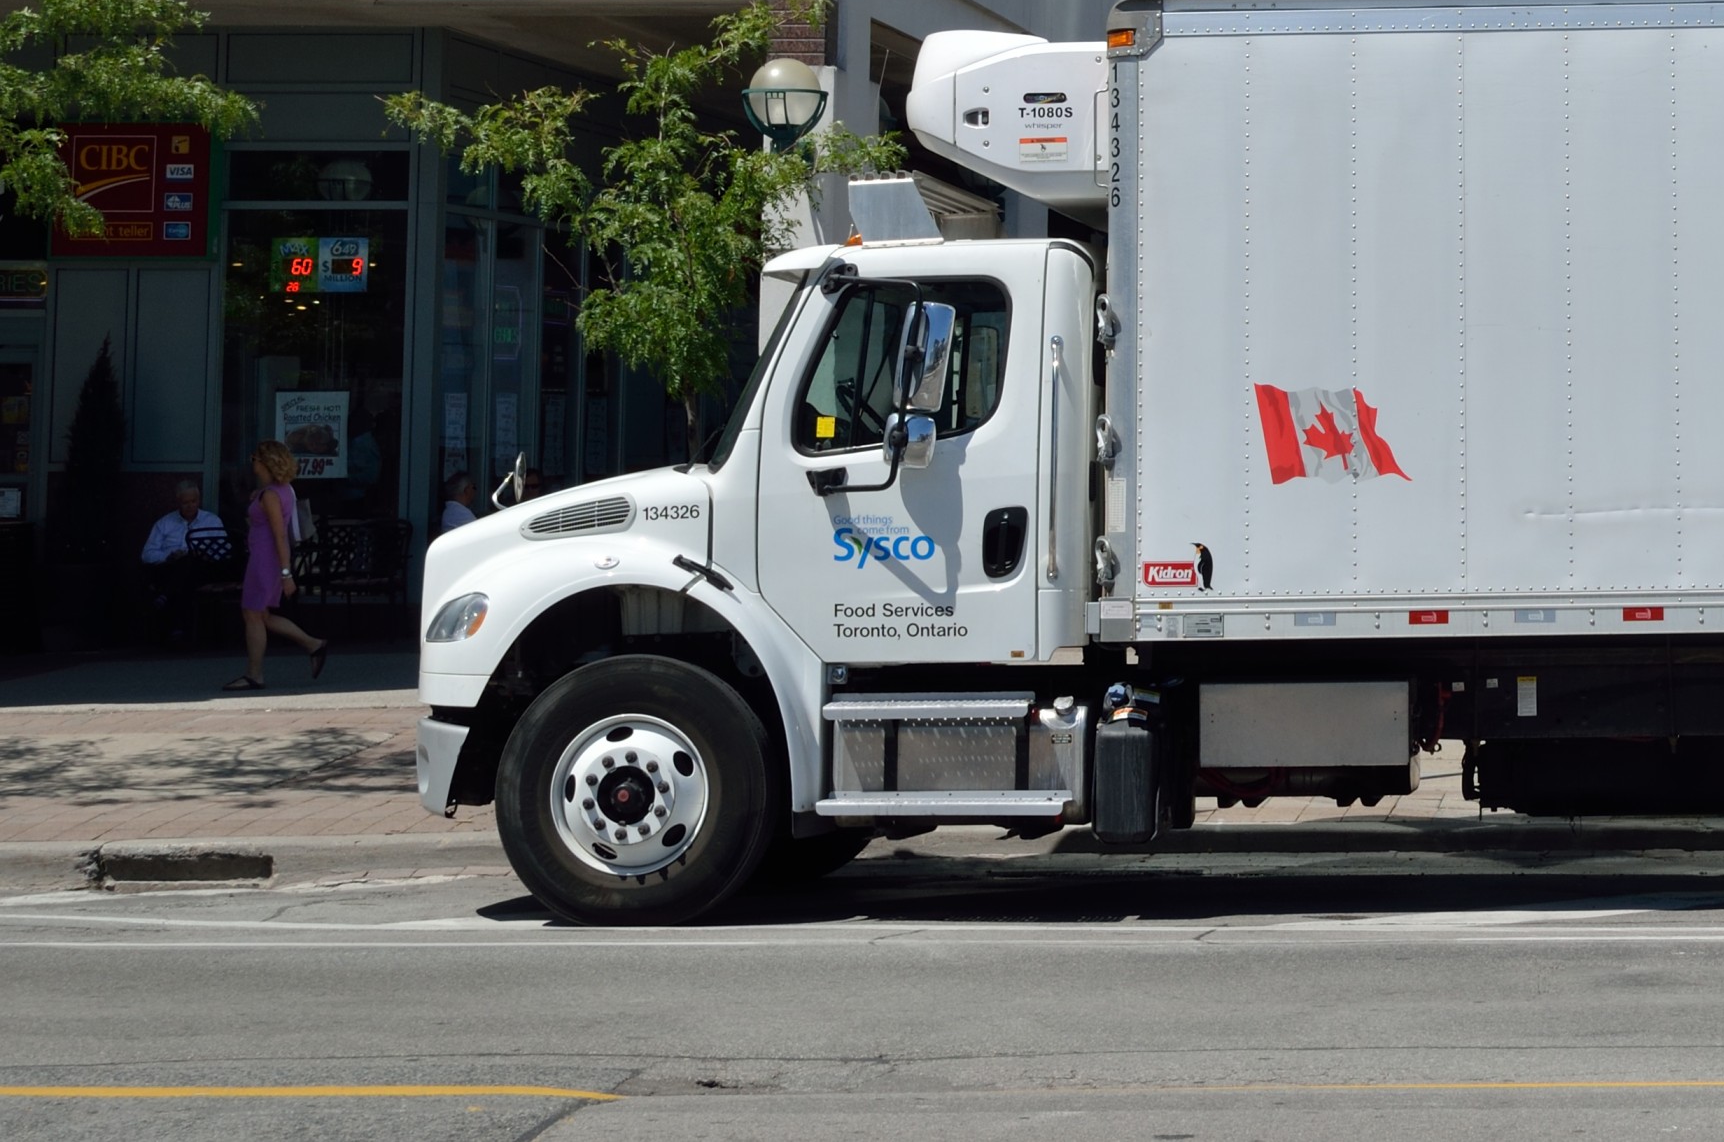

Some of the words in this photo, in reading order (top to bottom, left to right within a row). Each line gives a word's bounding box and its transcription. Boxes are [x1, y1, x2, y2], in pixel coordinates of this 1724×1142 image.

[1018, 106, 1073, 118] T-1080S
[1024, 122, 1063, 130] whisper
[1110, 63, 1121, 208] 134326
[79, 144, 150, 171] CIBC
[169, 166, 194, 176] VISA
[118, 224, 150, 237] teller
[291, 258, 313, 276] 60
[351, 257, 364, 276] 9
[324, 275, 362, 283] MILLION
[284, 413, 312, 422] Roasted
[313, 413, 341, 422] Chicken
[642, 504, 701, 522] 134326
[833, 515, 861, 525] Good
[862, 514, 893, 526] things
[857, 526, 885, 534] come
[886, 525, 910, 534] from
[833, 527, 936, 570] Sysco
[834, 603, 876, 618] Food
[882, 602, 954, 617] Services
[833, 623, 901, 639] Toronto,
[906, 622, 968, 637] Ontario
